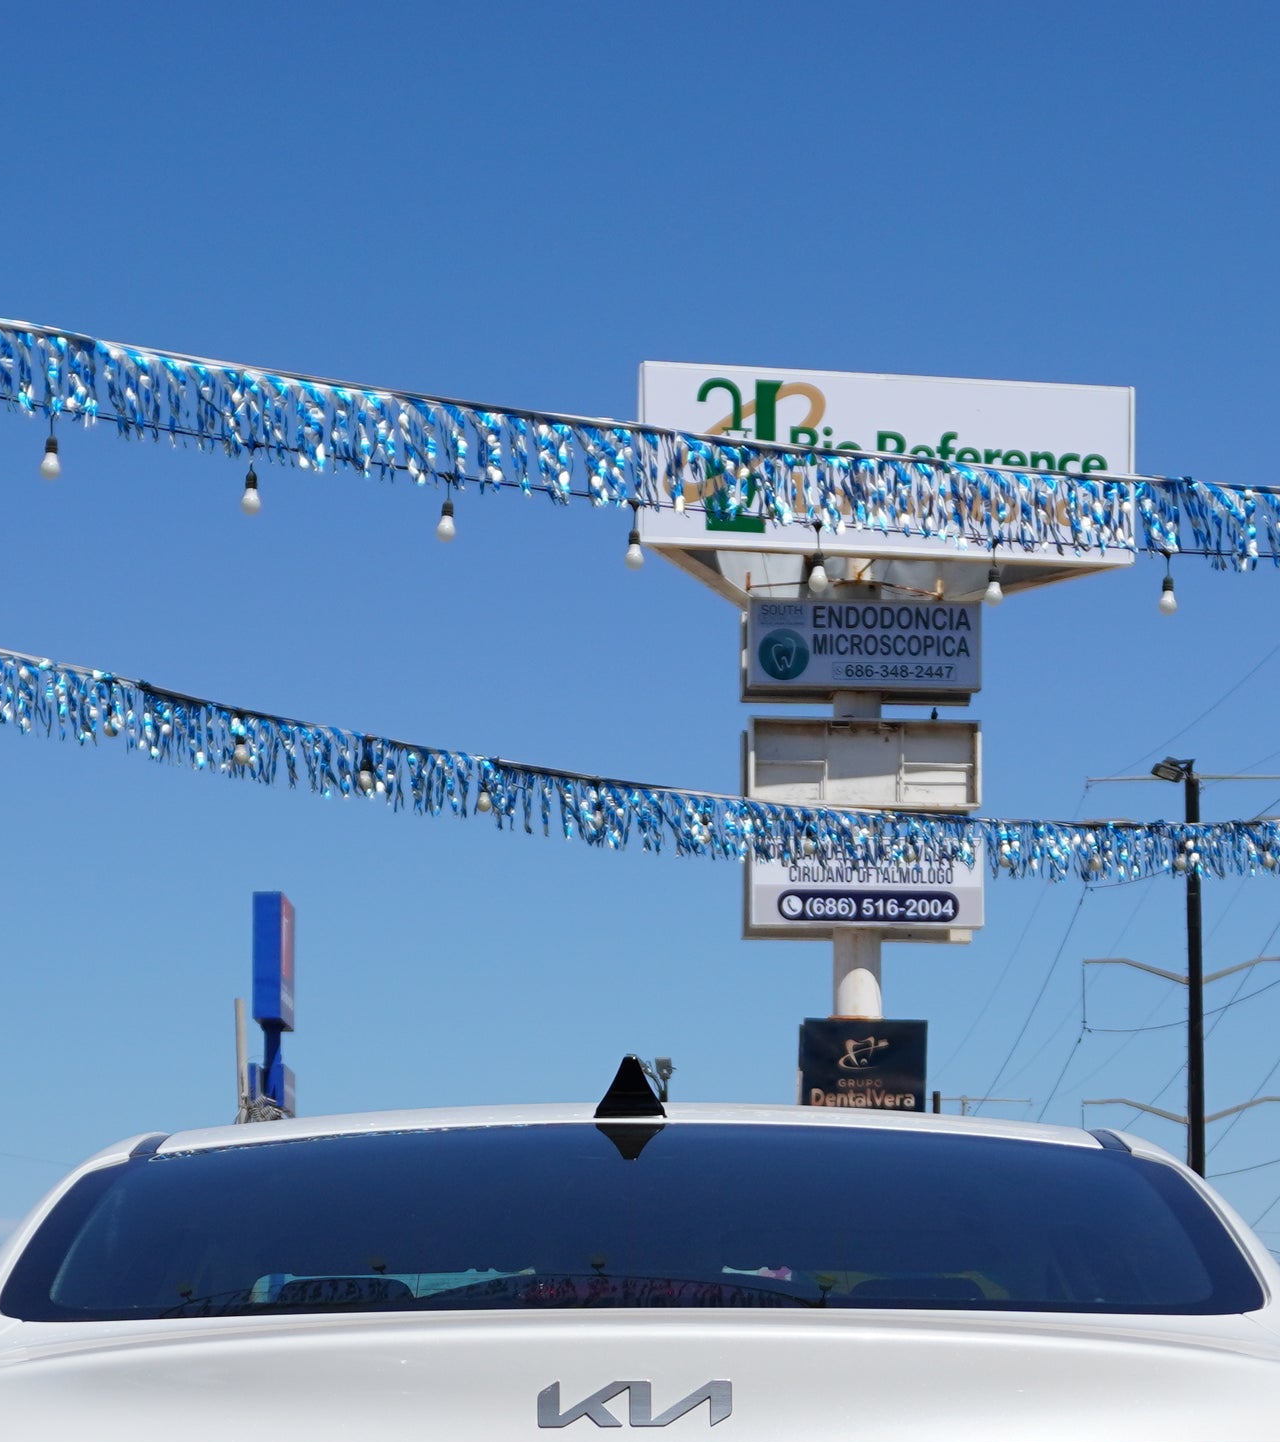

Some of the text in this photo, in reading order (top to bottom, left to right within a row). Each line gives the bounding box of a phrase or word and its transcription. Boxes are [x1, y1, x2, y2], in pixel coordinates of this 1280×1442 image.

[761, 604, 803, 616] SOUTH
[813, 606, 971, 631] ENDODONCIA
[813, 634, 970, 657] MICROSCOPICA
[845, 664, 954, 678] 686-348-2447
[788, 865, 853, 883] CIRUJANO
[805, 897, 955, 917] (686) 516-2004
[838, 1078, 883, 1087] GRUPO
[810, 1088, 916, 1107] DentalVera
[536, 1379, 733, 1428] KIA
